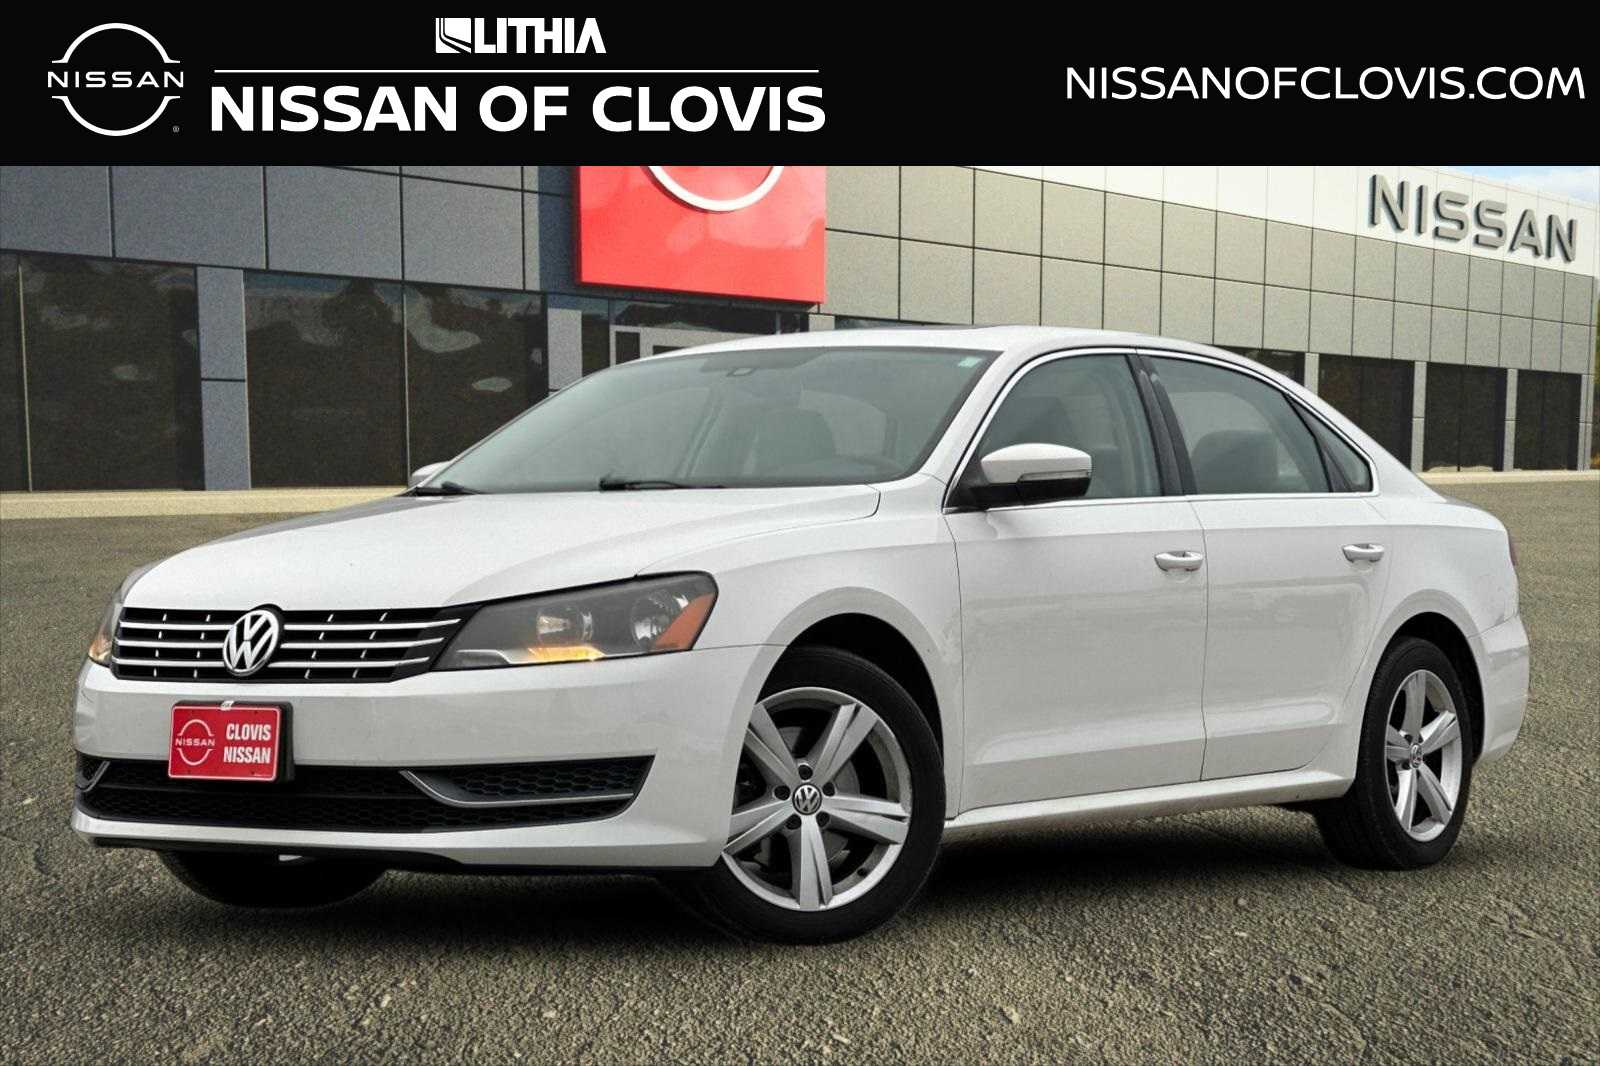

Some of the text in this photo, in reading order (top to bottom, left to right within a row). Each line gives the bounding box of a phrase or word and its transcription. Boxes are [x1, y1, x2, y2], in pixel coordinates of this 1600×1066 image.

[1368, 174, 1578, 263] NISSAN
[225, 723, 272, 741] CLOVIS
[174, 737, 216, 747] NISSAN
[223, 746, 272, 764] NISSAN
